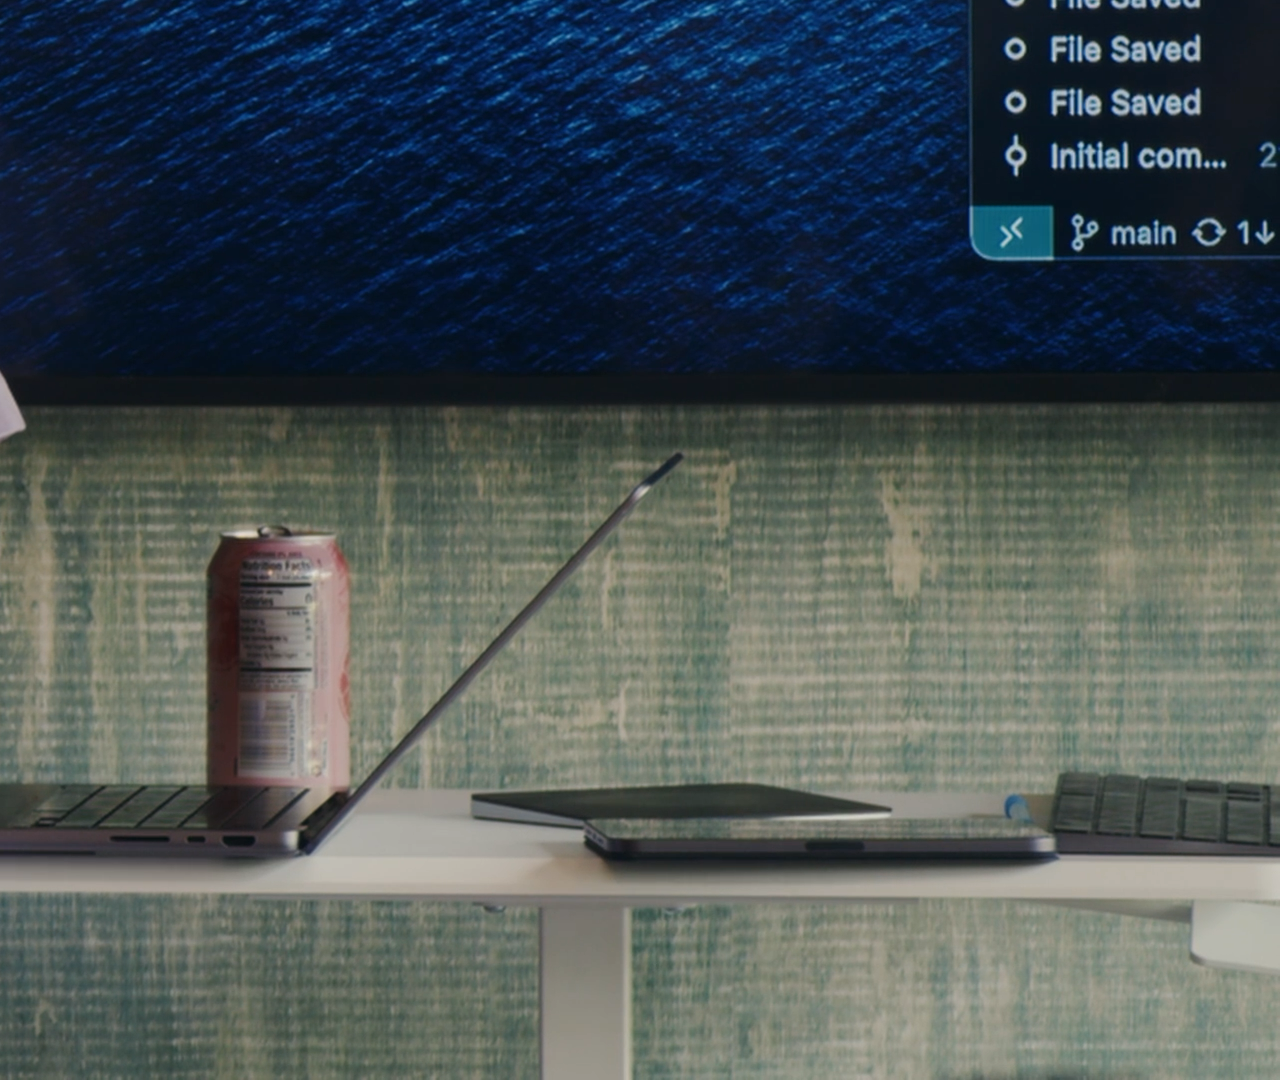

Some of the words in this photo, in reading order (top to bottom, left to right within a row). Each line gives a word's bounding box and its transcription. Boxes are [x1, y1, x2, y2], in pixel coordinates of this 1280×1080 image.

[1049, 34, 1102, 63] File
[1109, 33, 1201, 63] Saved
[1050, 87, 1102, 117] File
[1110, 87, 1202, 117] Saved
[1050, 141, 1129, 170] Initial
[1137, 147, 1227, 170] com...
[1258, 141, 1280, 169] 2
[1110, 219, 1177, 246] main
[1236, 220, 1249, 245] 1
